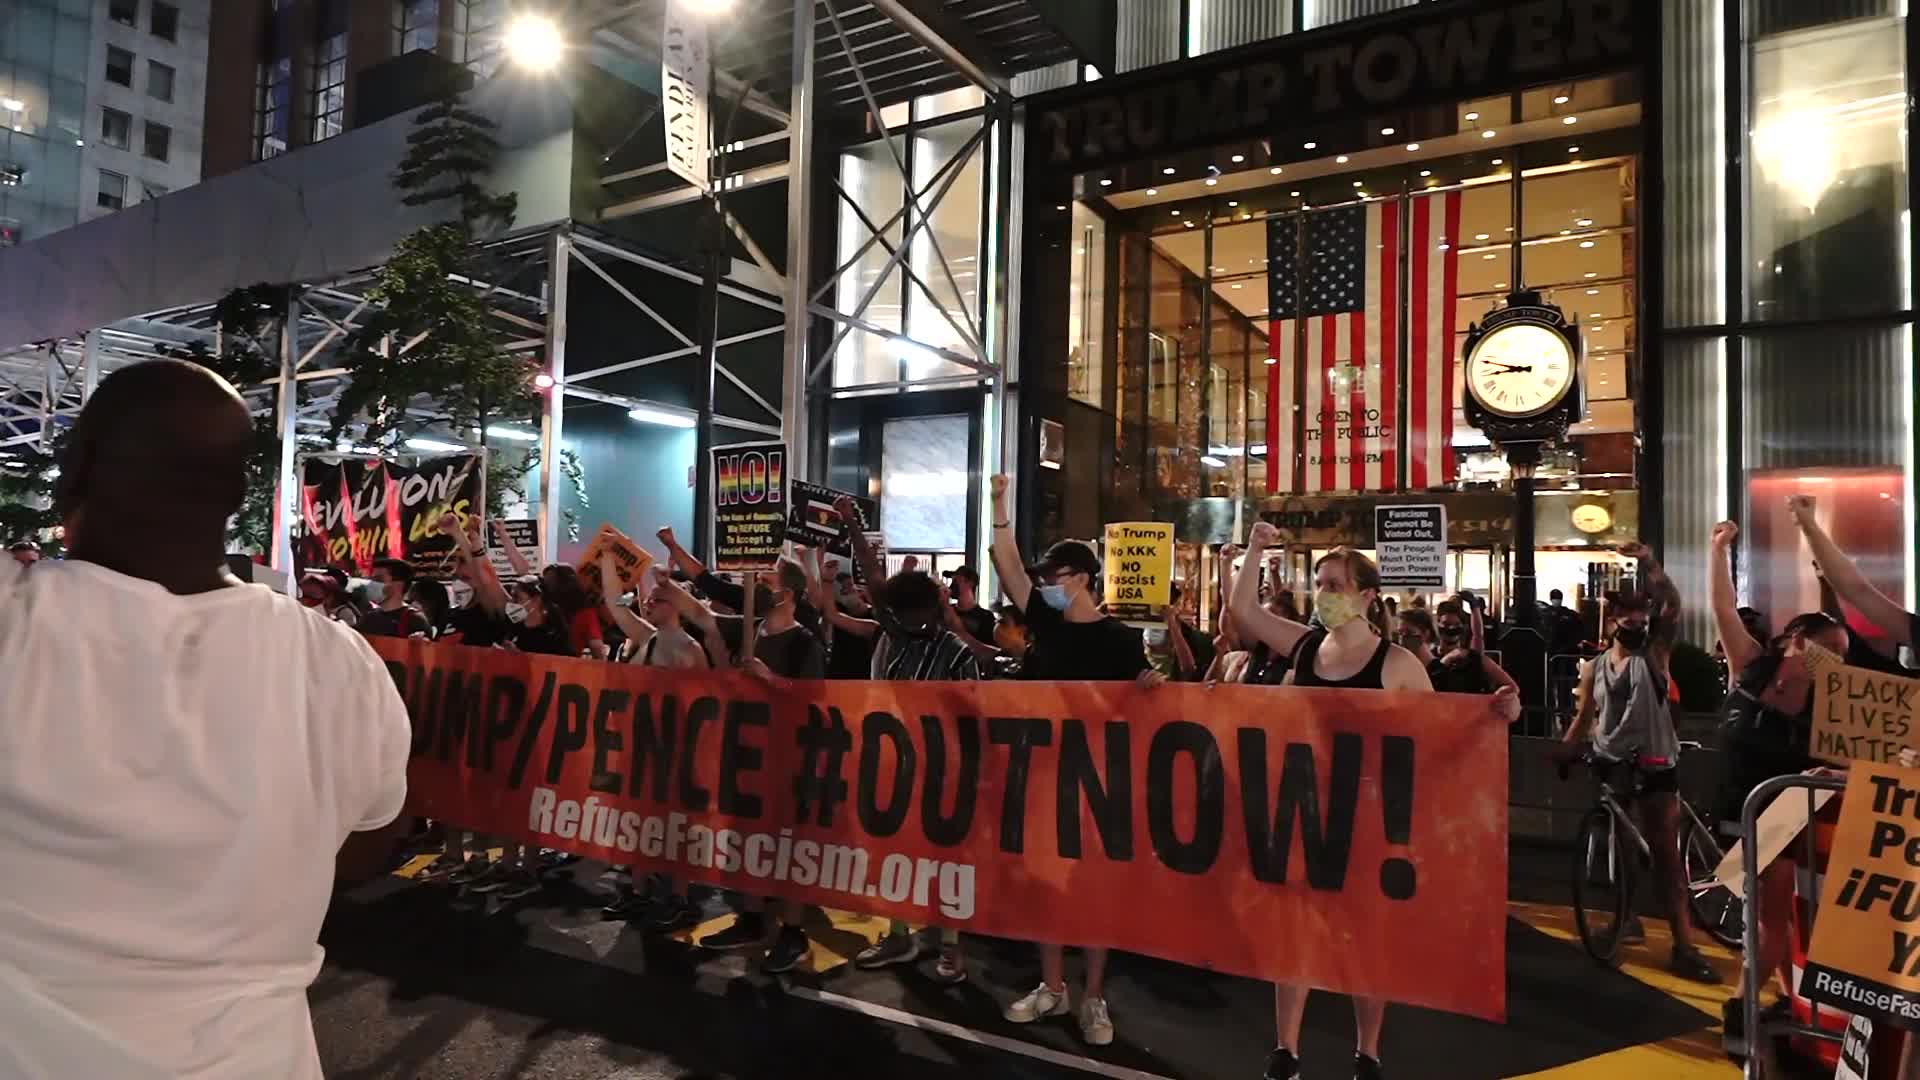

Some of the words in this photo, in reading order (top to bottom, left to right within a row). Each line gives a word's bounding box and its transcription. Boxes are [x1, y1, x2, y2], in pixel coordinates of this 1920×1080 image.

[1042, 62, 1287, 161] TRUMP
[1303, 0, 1633, 112] TOWER
[1337, 424, 1392, 440] PULIC
[718, 451, 782, 506] NO!
[1384, 520, 1418, 529] Cannot
[1420, 519, 1434, 528] Be
[1123, 528, 1167, 541] Trump
[1384, 529, 1412, 539] Voted
[1110, 547, 1124, 557] No
[1126, 545, 1156, 557] KKK
[1384, 545, 1401, 553] The
[1403, 544, 1435, 554] People
[1380, 555, 1402, 563] Must
[1406, 554, 1430, 562] Drive
[1121, 561, 1141, 573] NO
[1382, 565, 1405, 573] From
[1408, 564, 1438, 573] Power
[1117, 587, 1144, 600] USA
[1826, 671, 1912, 712] BLACK
[1828, 701, 1911, 737] LIVES
[1818, 729, 1908, 764] MATTE
[795, 703, 1418, 901] #OUTNOW!
[1870, 775, 1920, 820] Tr
[529, 786, 976, 920] RefuseFascism.org
